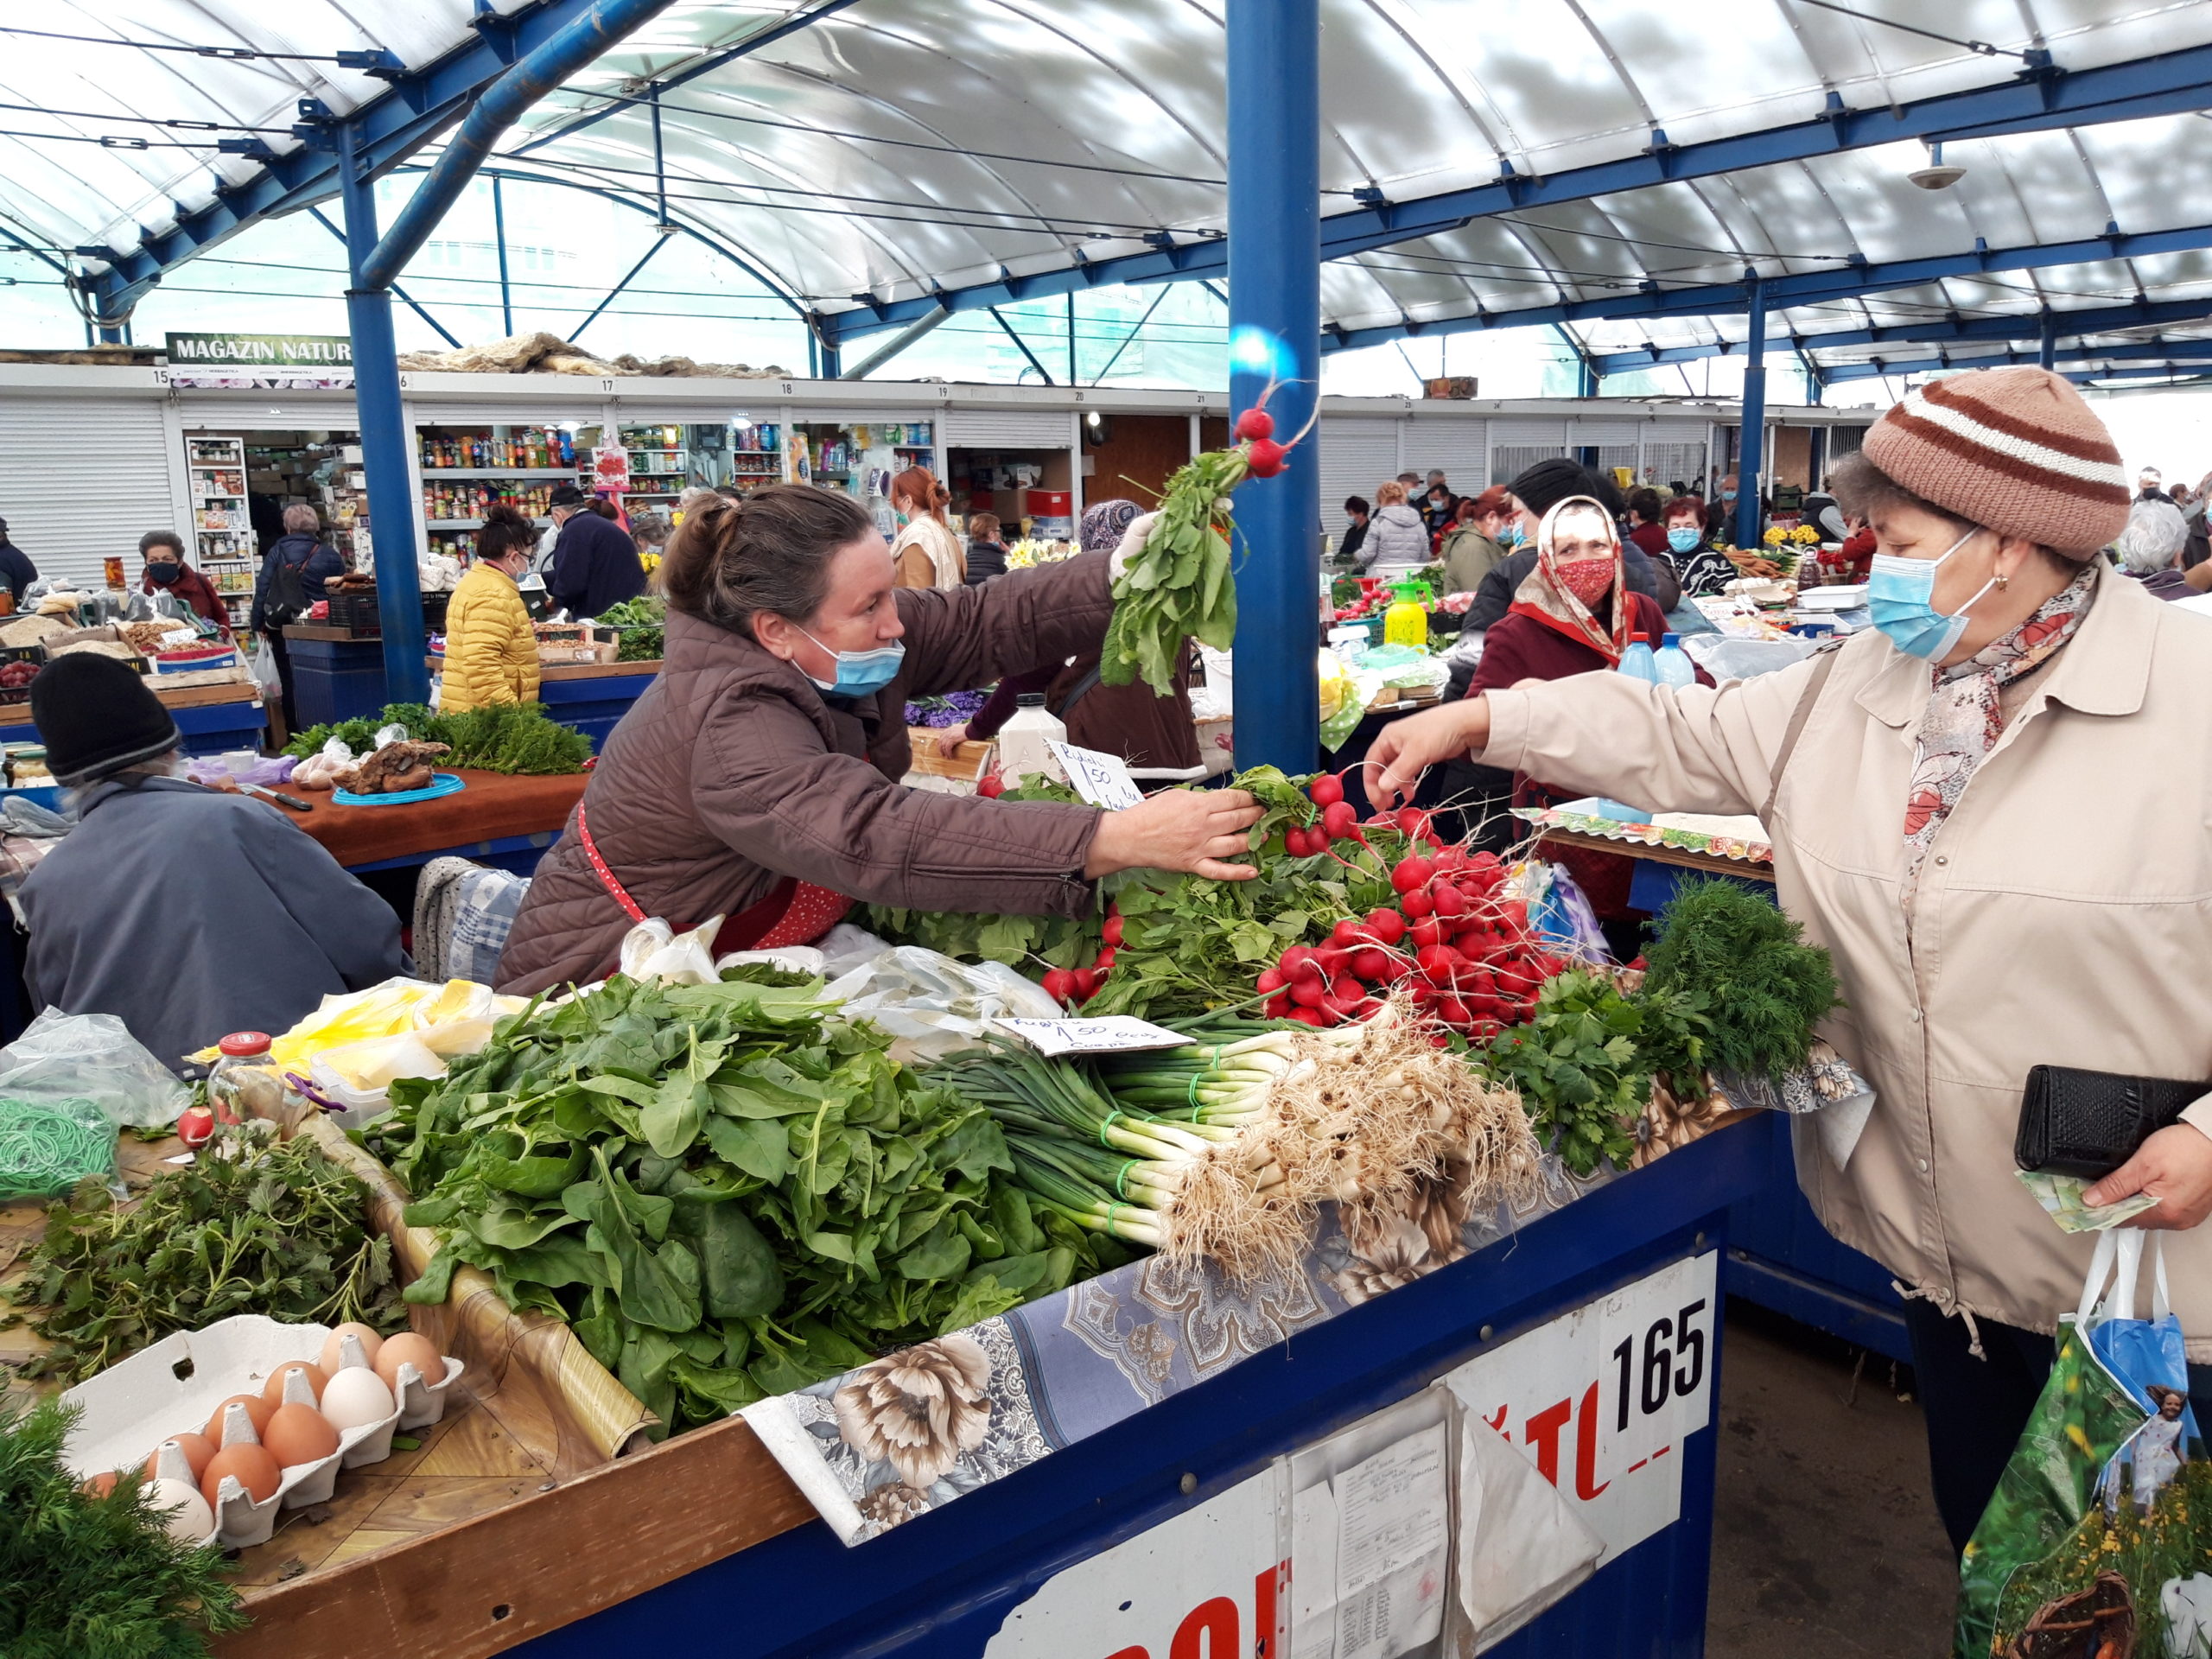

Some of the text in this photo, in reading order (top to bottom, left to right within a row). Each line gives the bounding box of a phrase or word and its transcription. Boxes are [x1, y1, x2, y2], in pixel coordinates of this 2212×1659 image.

[176, 339, 352, 361] MAGAZIN NATUR
[153, 371, 168, 384] 15
[400, 375, 407, 387] 6
[602, 379, 613, 391] 17
[782, 384, 792, 395] 18
[938, 387, 948, 397] 19
[1075, 391, 1084, 401] 20
[1613, 1298, 1706, 1433] 165
